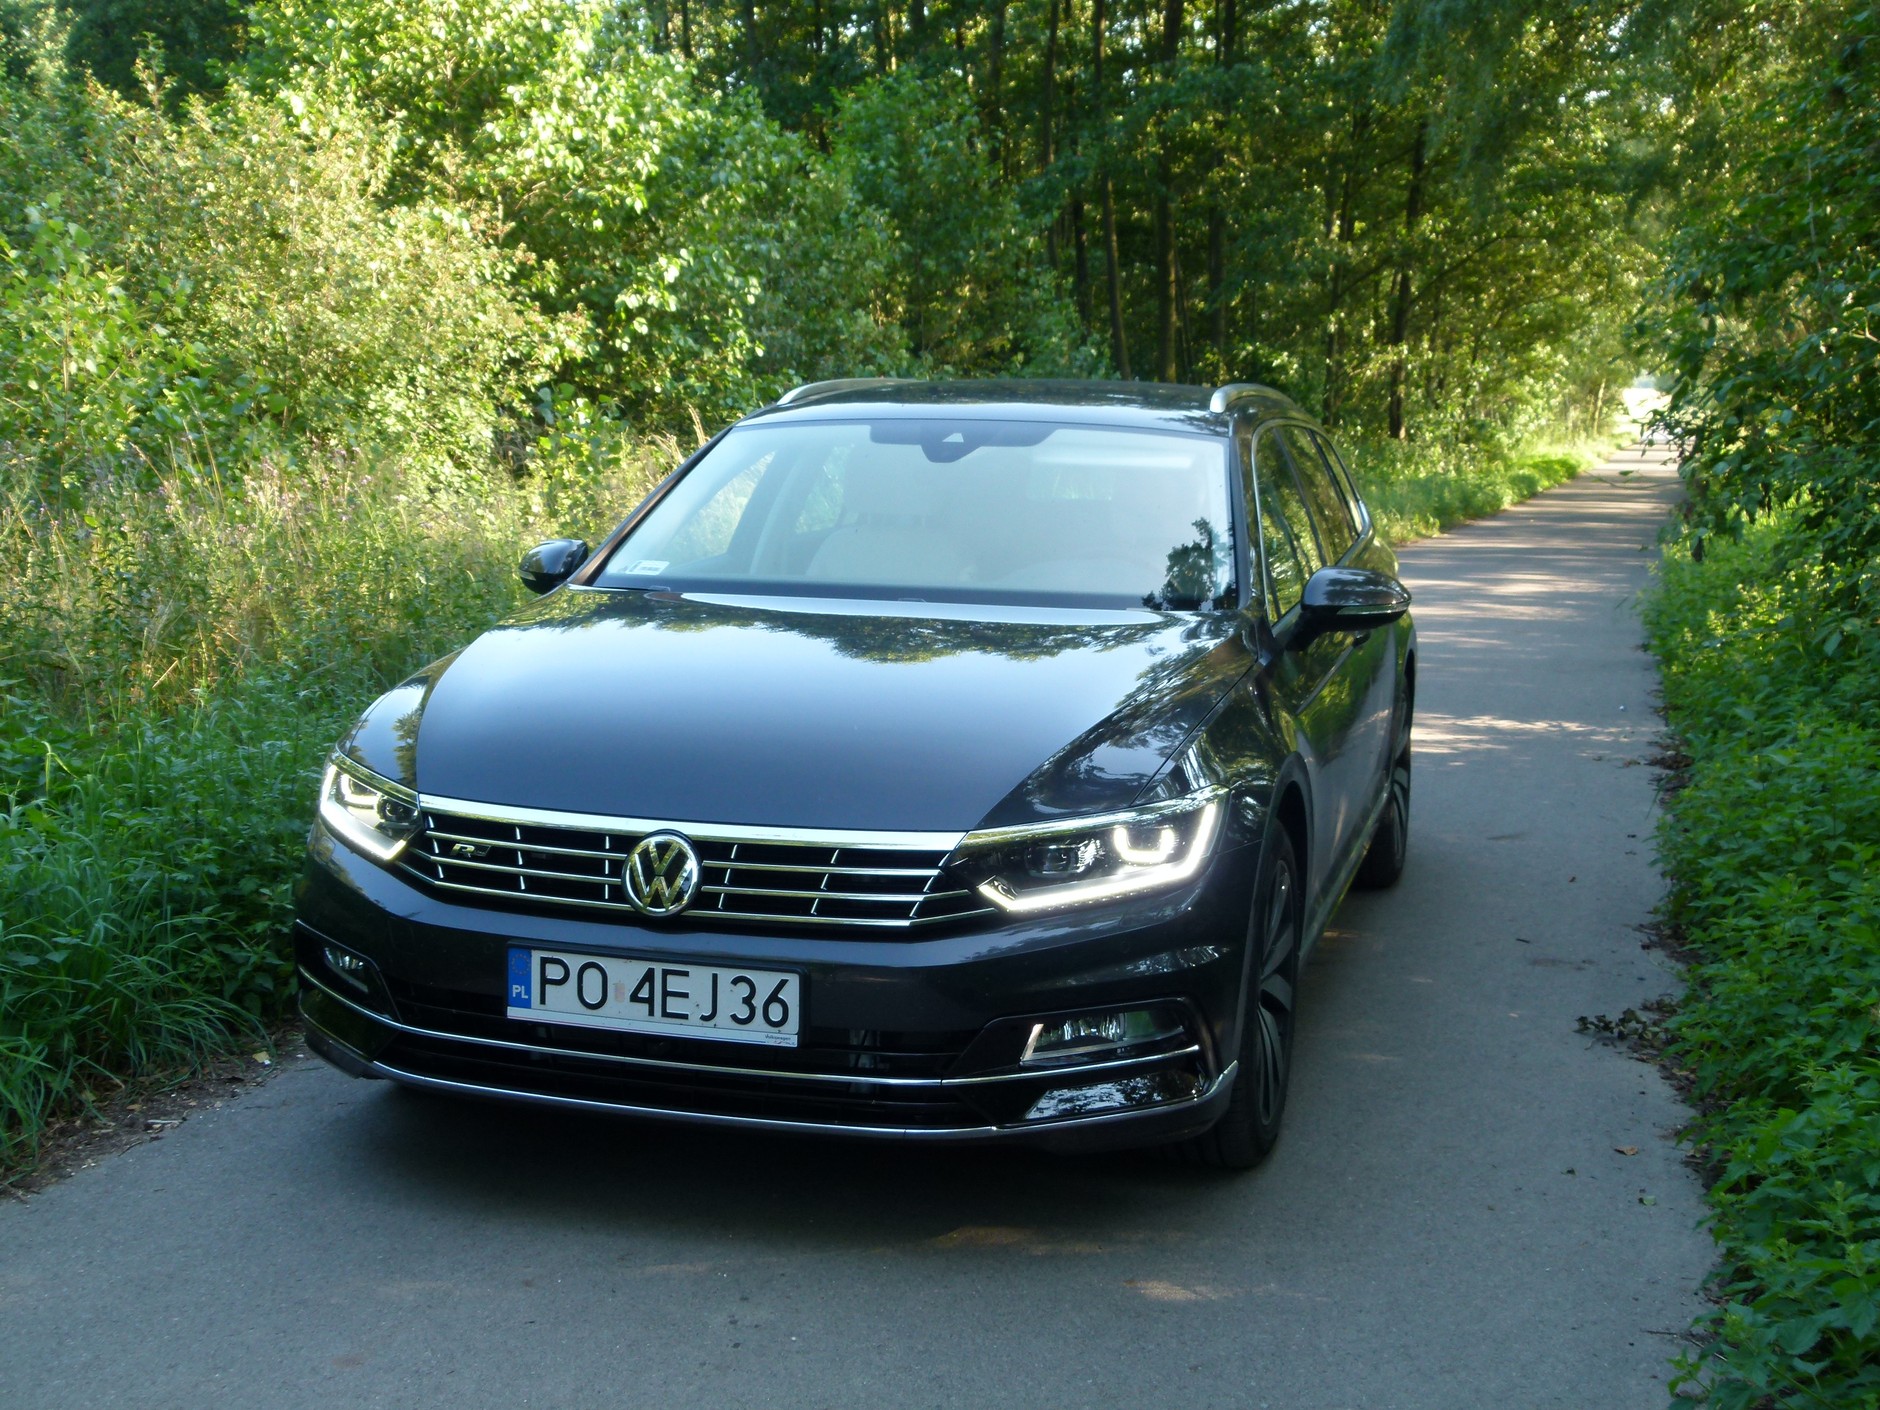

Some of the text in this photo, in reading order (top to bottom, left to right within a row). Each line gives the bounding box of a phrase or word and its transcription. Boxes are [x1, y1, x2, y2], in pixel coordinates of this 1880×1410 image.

[512, 984, 529, 999] PL
[539, 956, 790, 1028] PO 4EJ36
